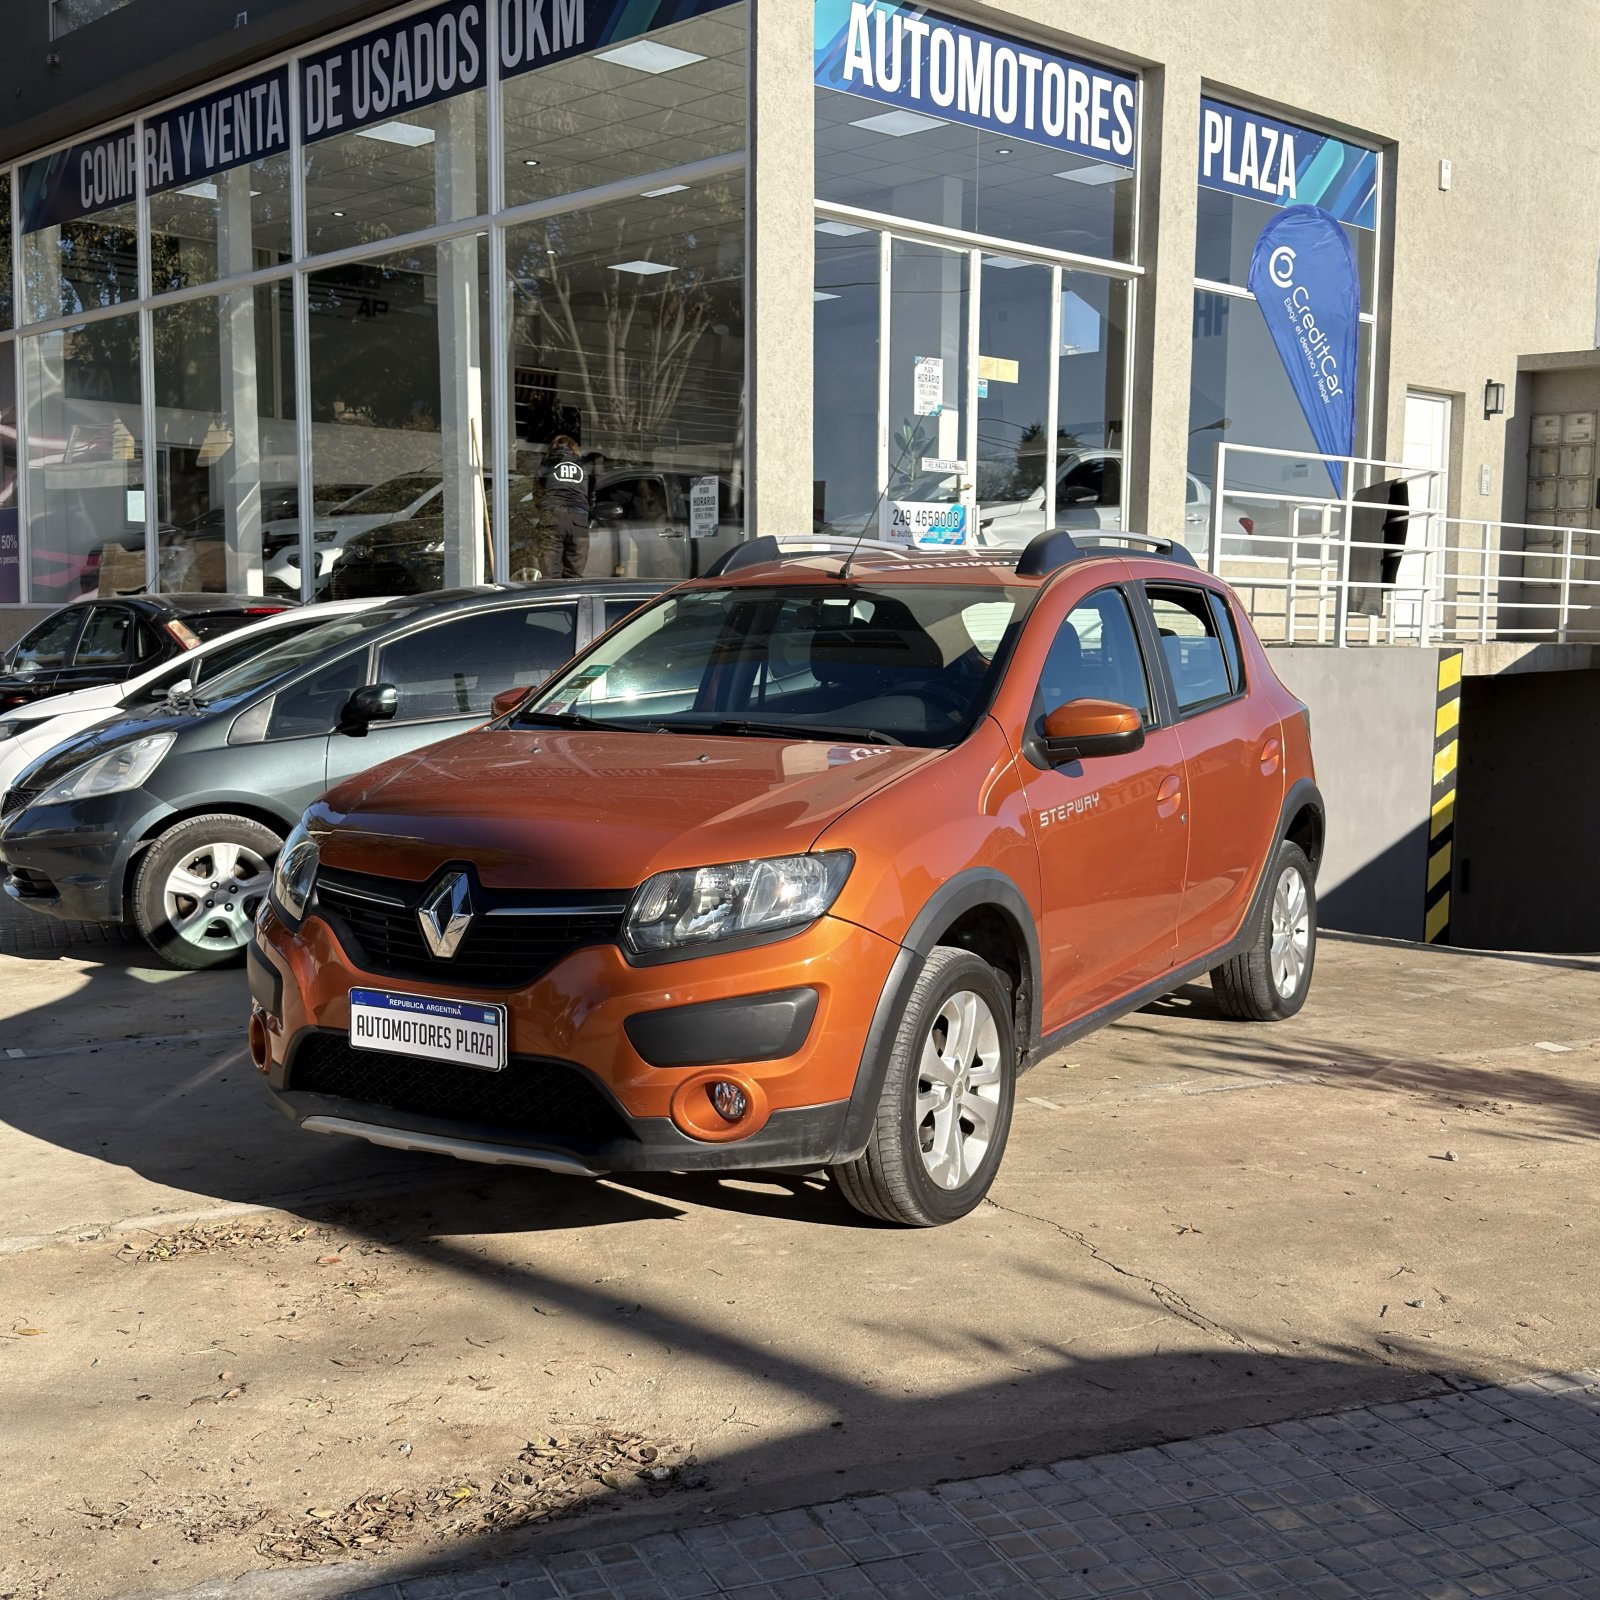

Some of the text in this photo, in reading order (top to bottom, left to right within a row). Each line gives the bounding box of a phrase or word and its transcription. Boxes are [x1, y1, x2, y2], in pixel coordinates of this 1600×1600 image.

[80, 121, 174, 209] COMPRA
[179, 111, 195, 176] Y
[201, 79, 285, 169] VENTA
[305, 57, 344, 136] DE
[351, 4, 479, 120] USADOS
[843, 1, 1297, 200] AUTOMOTORES PLAZA
[1283, 297, 1298, 323] Elegir
[1293, 286, 1343, 397] CreditCar
[1295, 325, 1304, 335] el
[1299, 336, 1316, 370] destino
[1317, 378, 1331, 404] llegar
[560, 464, 578, 479] AP
[692, 496, 716, 506] HORARIO
[892, 508, 959, 528] 249 4658008
[1, 534, 18, 550] 50%
[1039, 792, 1100, 828] STEPWAY
[389, 998, 462, 1016] REPUBLICA ARGENTINA
[356, 1014, 494, 1057] AUTOMOTORES PLAZA
